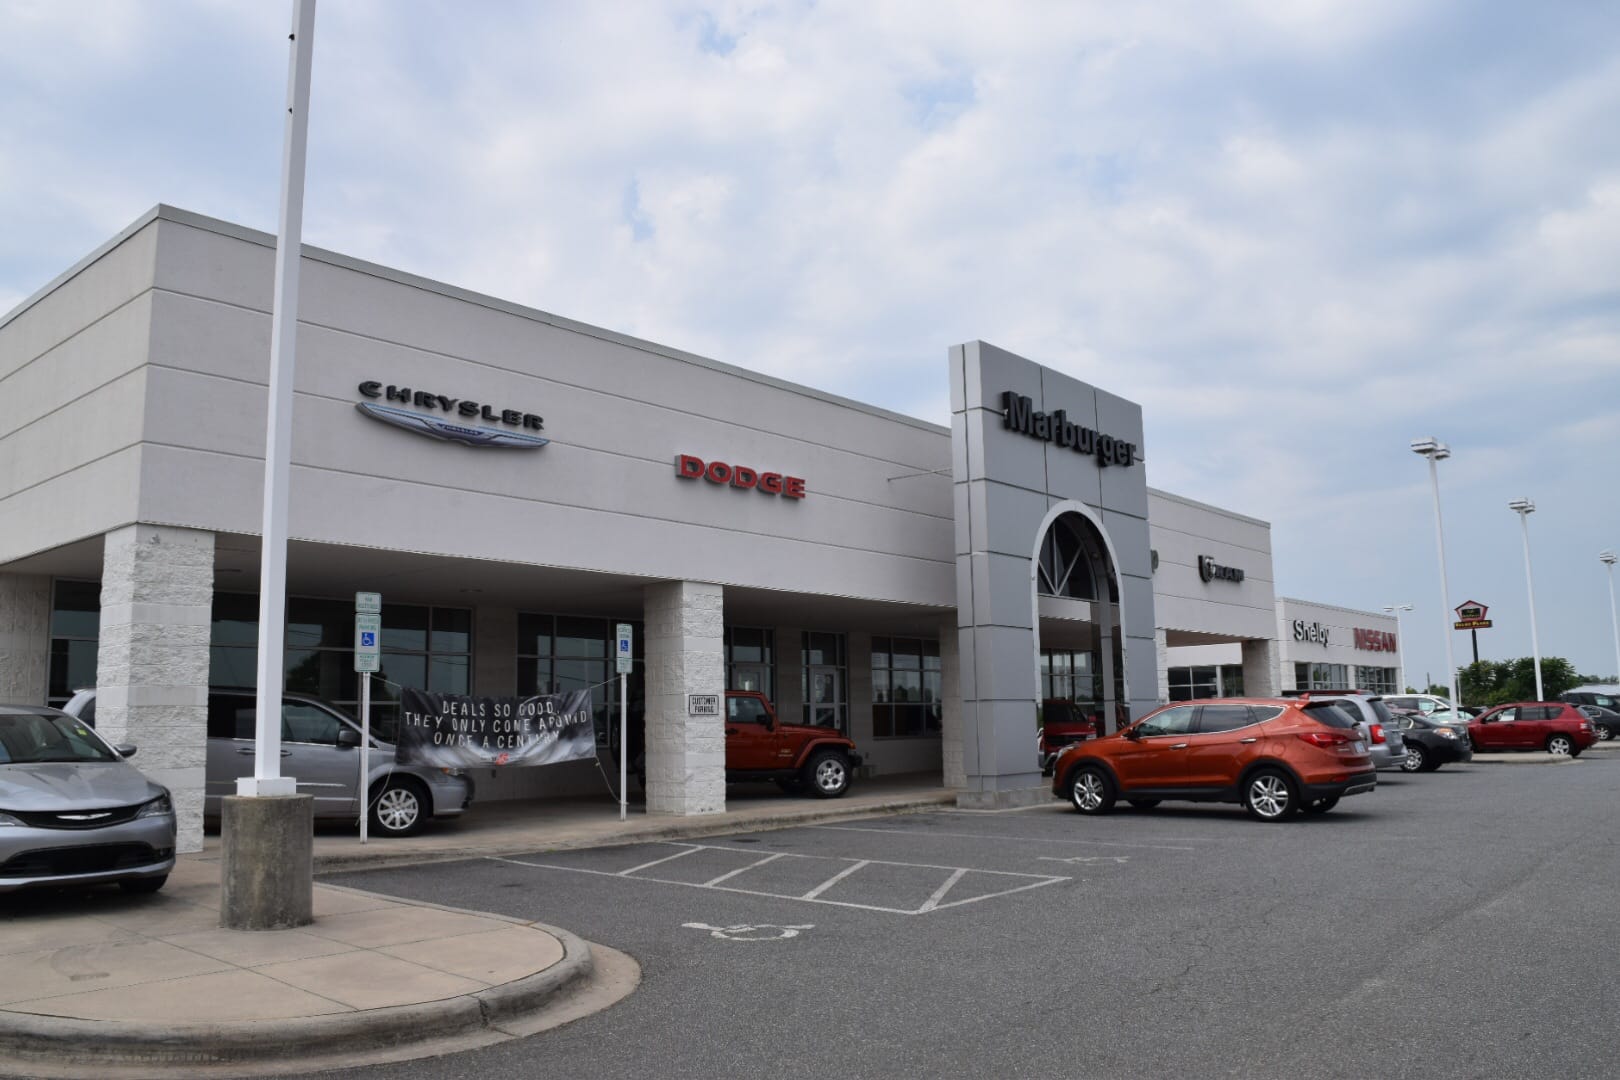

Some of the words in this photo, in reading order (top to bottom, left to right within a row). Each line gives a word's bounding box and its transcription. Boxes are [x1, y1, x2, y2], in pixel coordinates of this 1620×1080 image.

[358, 380, 545, 430] CHRYSLER
[1001, 391, 1136, 467] Marburger
[675, 454, 806, 501] DODGE
[1293, 619, 1330, 648] Shelby
[1353, 627, 1397, 653] NISSAN
[442, 700, 486, 716] DEALS
[494, 703, 511, 717] SO
[692, 697, 716, 705] CUSTOMER
[405, 711, 443, 729] THEY
[451, 717, 486, 733] ONLY
[493, 718, 530, 733] COME
[539, 710, 587, 730] AROUND
[434, 731, 473, 747] ONCE
[482, 735, 489, 749] A
